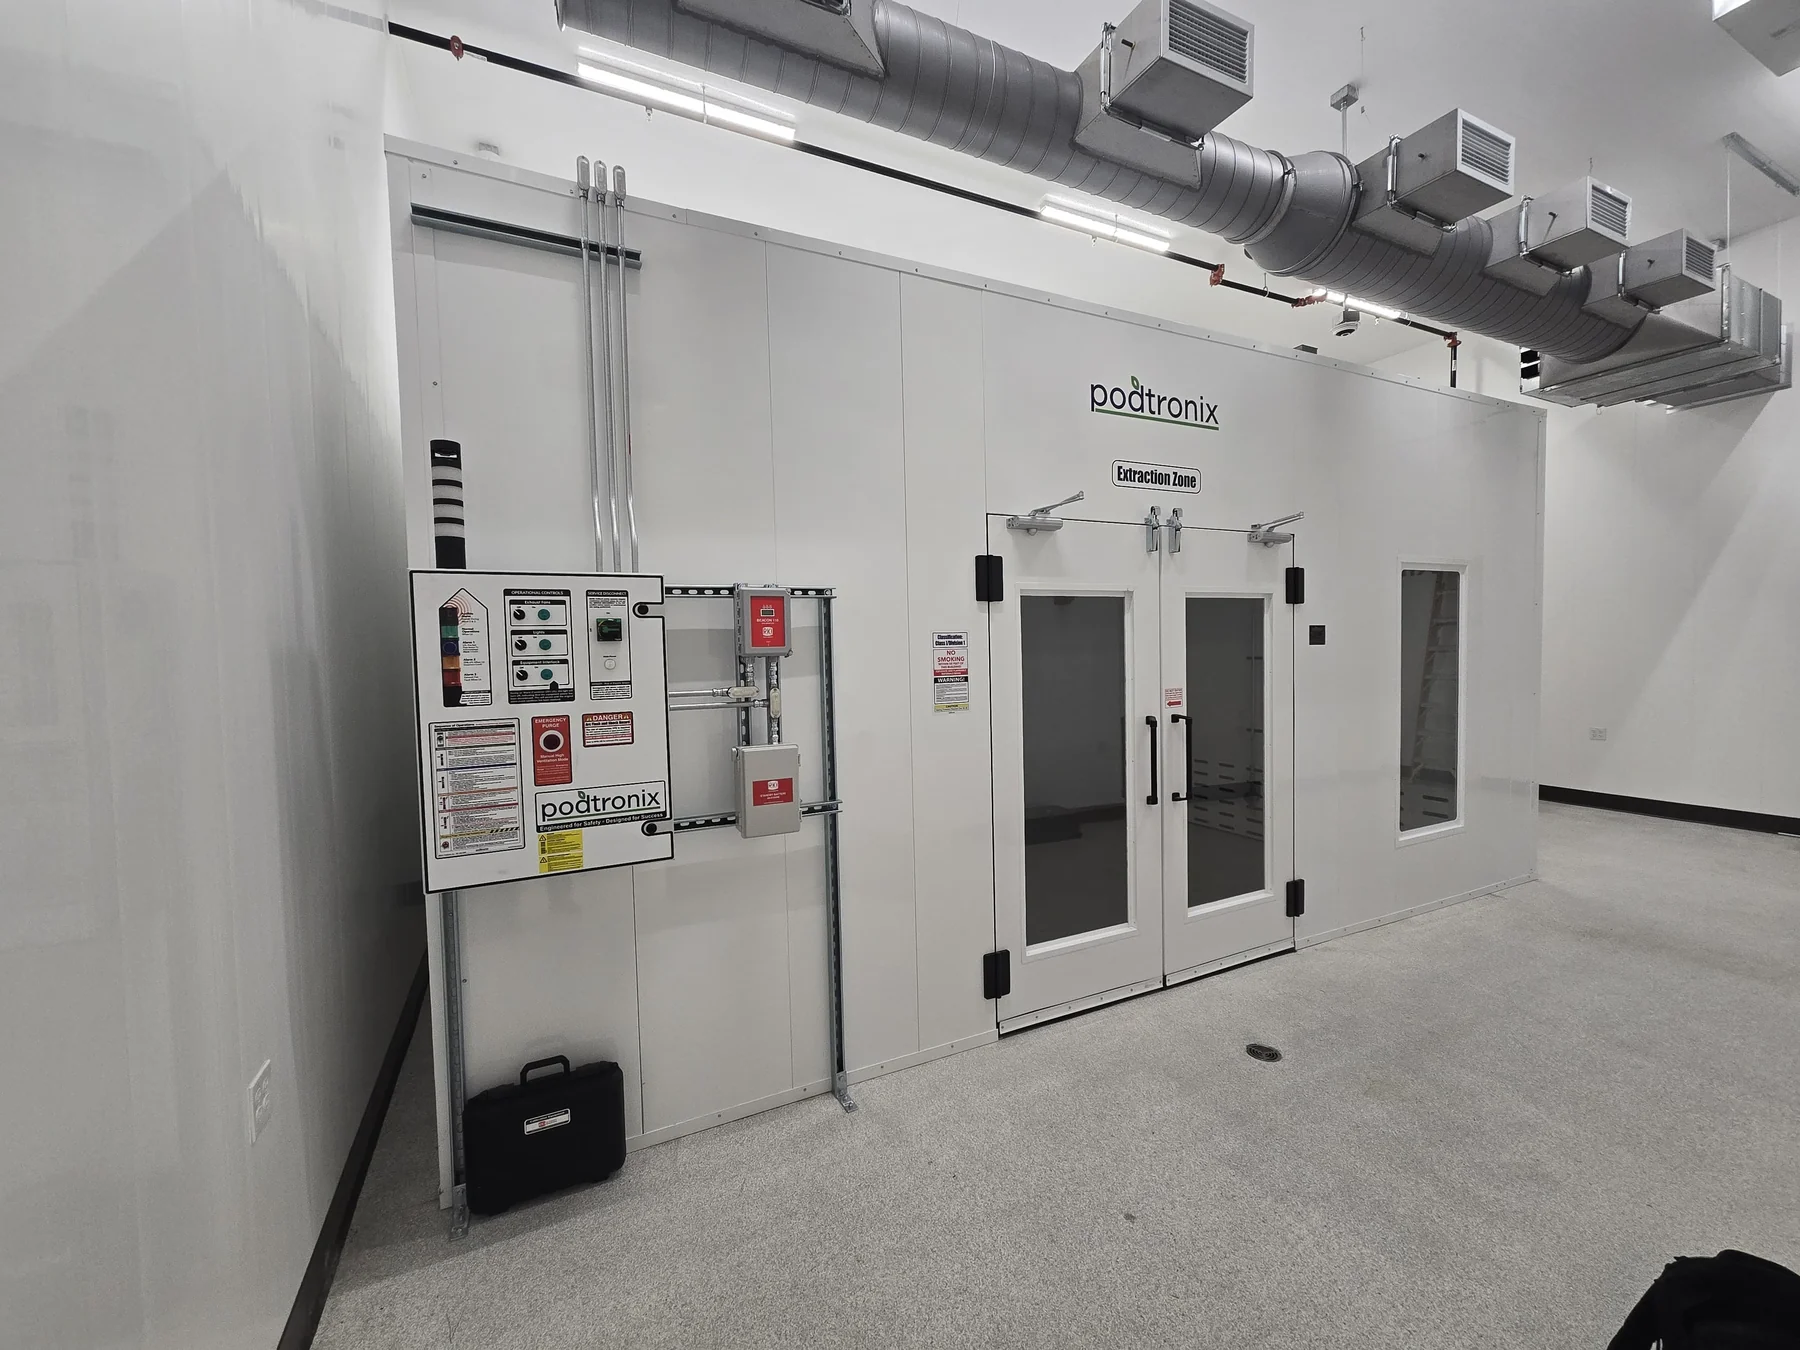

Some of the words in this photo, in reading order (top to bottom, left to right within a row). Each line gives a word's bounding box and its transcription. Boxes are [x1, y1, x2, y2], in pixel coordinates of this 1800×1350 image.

[1090, 383, 1219, 425] podtronix
[1117, 465, 1171, 486] Extraction
[1172, 471, 1197, 489] Zone
[592, 713, 623, 721] DANGER
[541, 789, 661, 822] podtronix
[539, 822, 573, 832] Engineered
[583, 819, 601, 827] Safety
[605, 816, 631, 824] Designed
